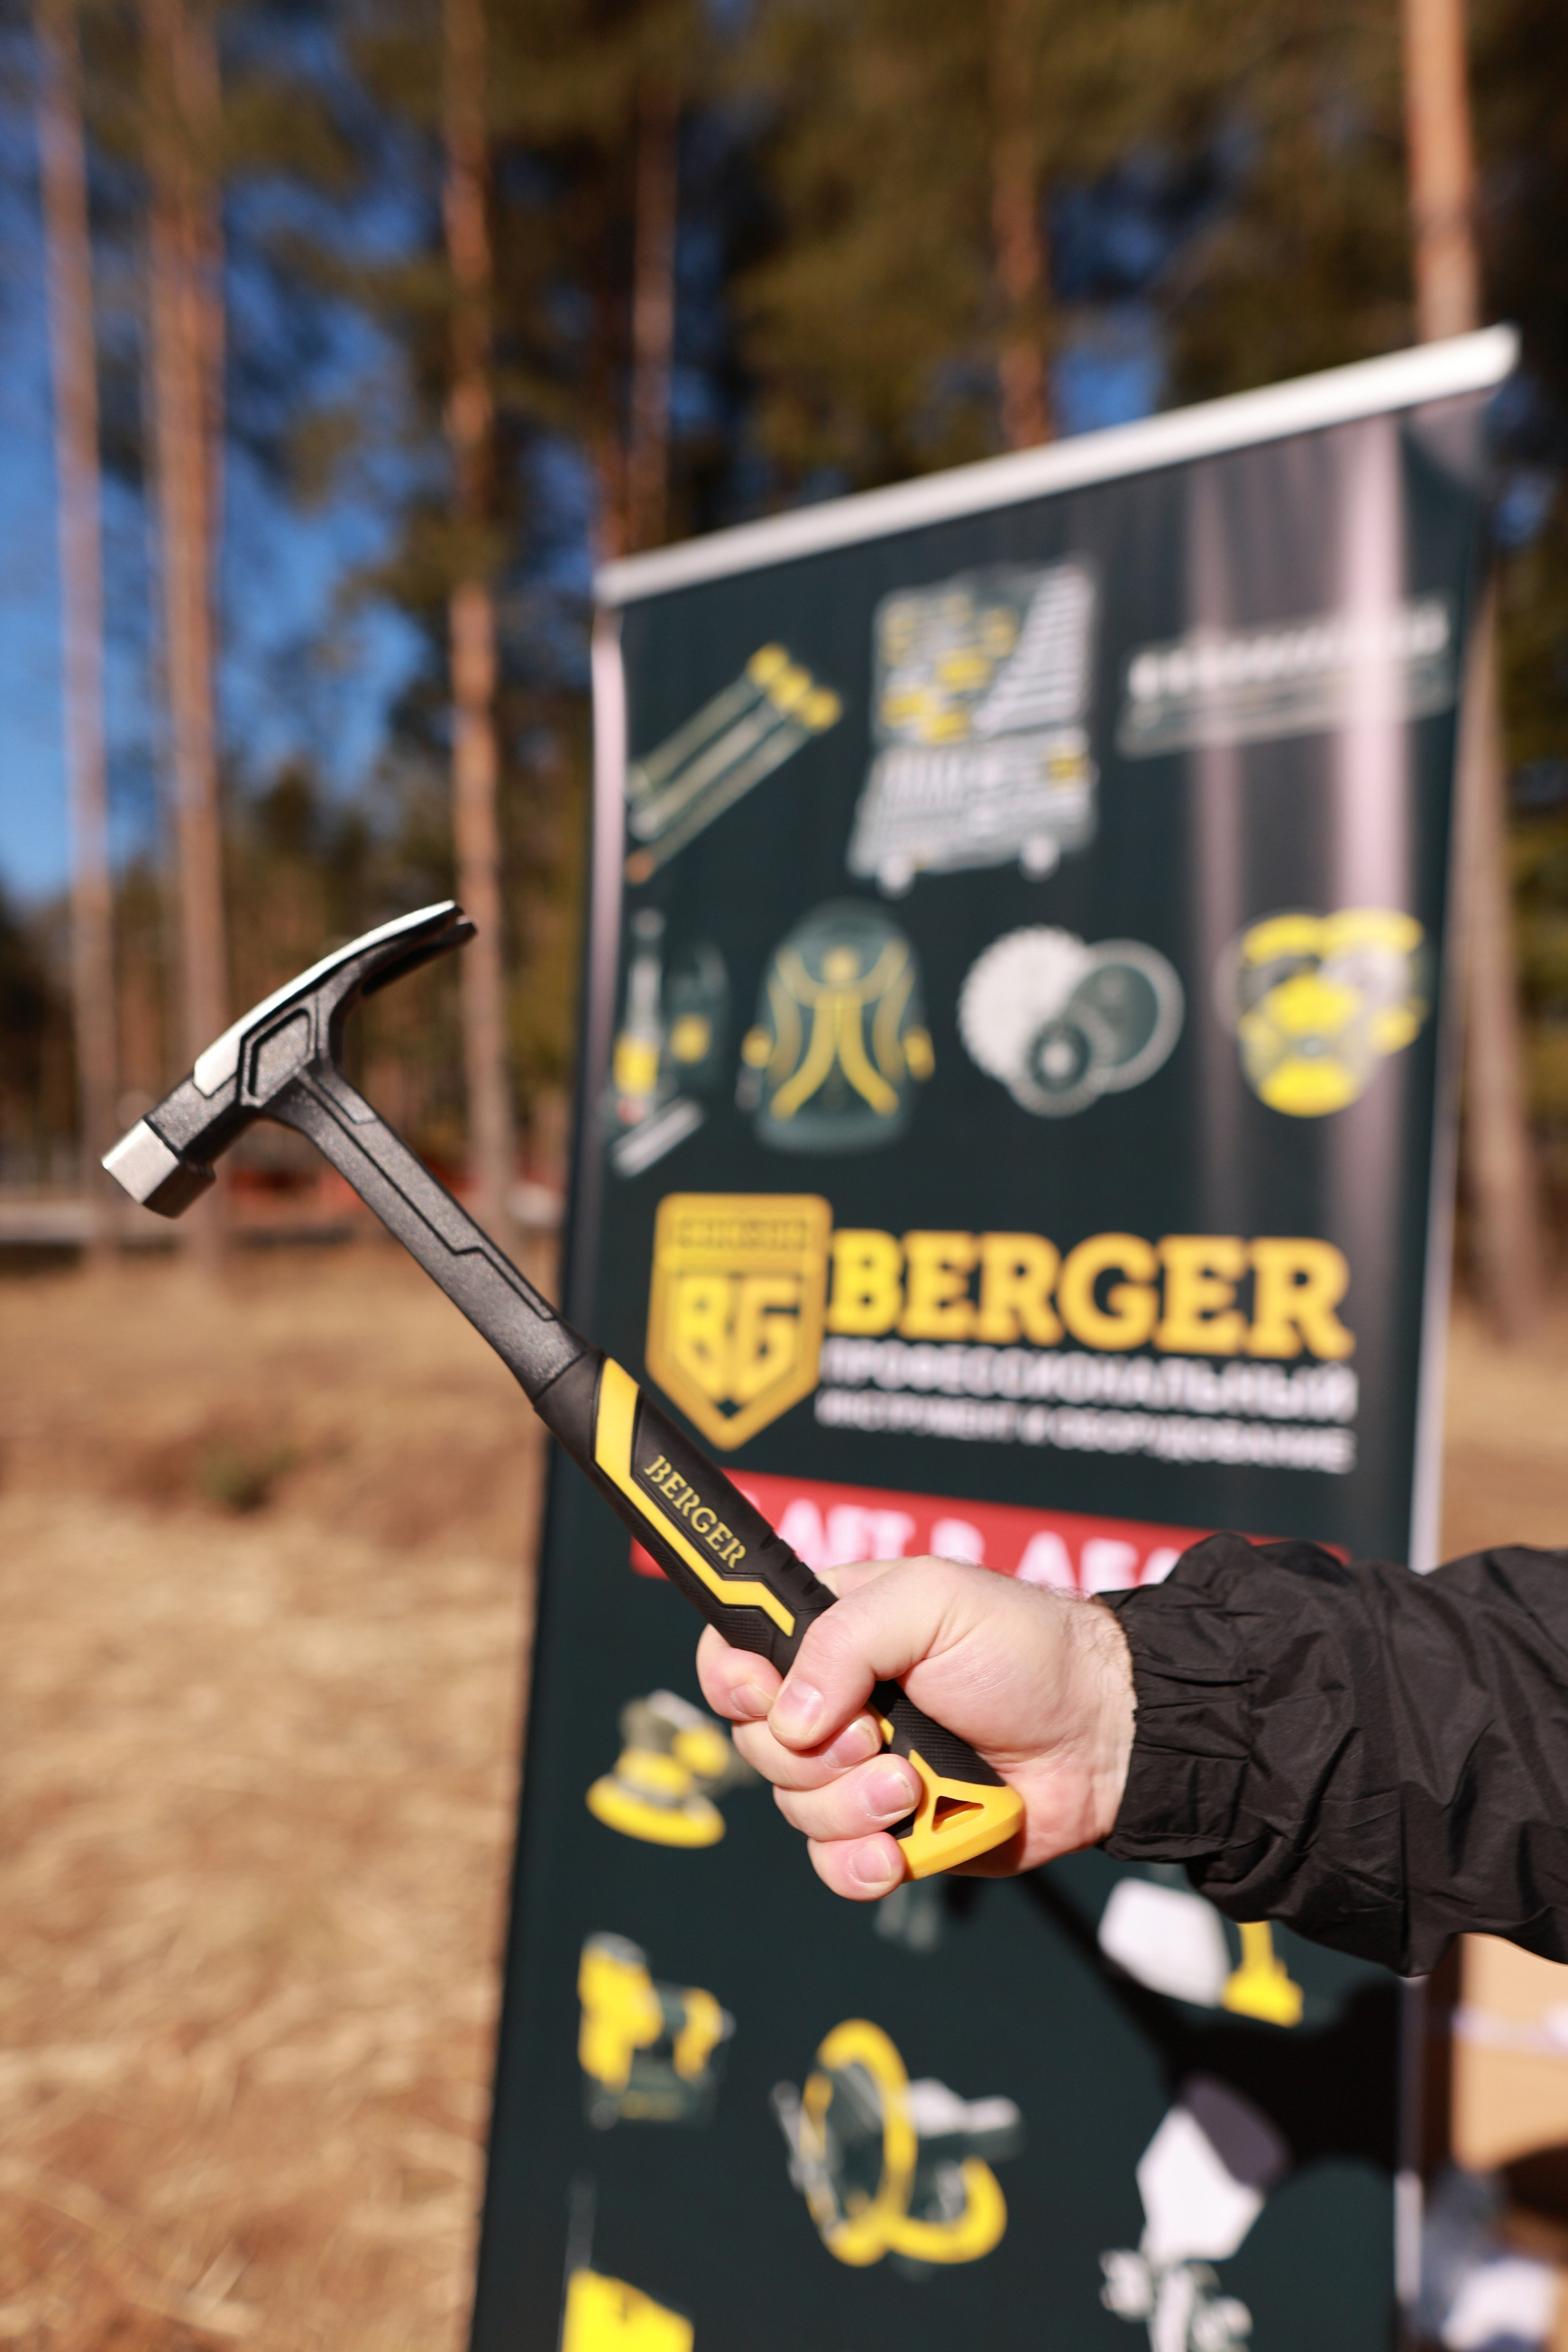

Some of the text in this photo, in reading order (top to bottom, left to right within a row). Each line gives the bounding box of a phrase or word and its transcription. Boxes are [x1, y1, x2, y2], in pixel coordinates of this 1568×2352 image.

[826, 1229, 1354, 1360] BERGER
[820, 1336, 1357, 1421] ПРОФЕССИОНАЛЬНЫЙ
[644, 1454, 747, 1569] BERGER
